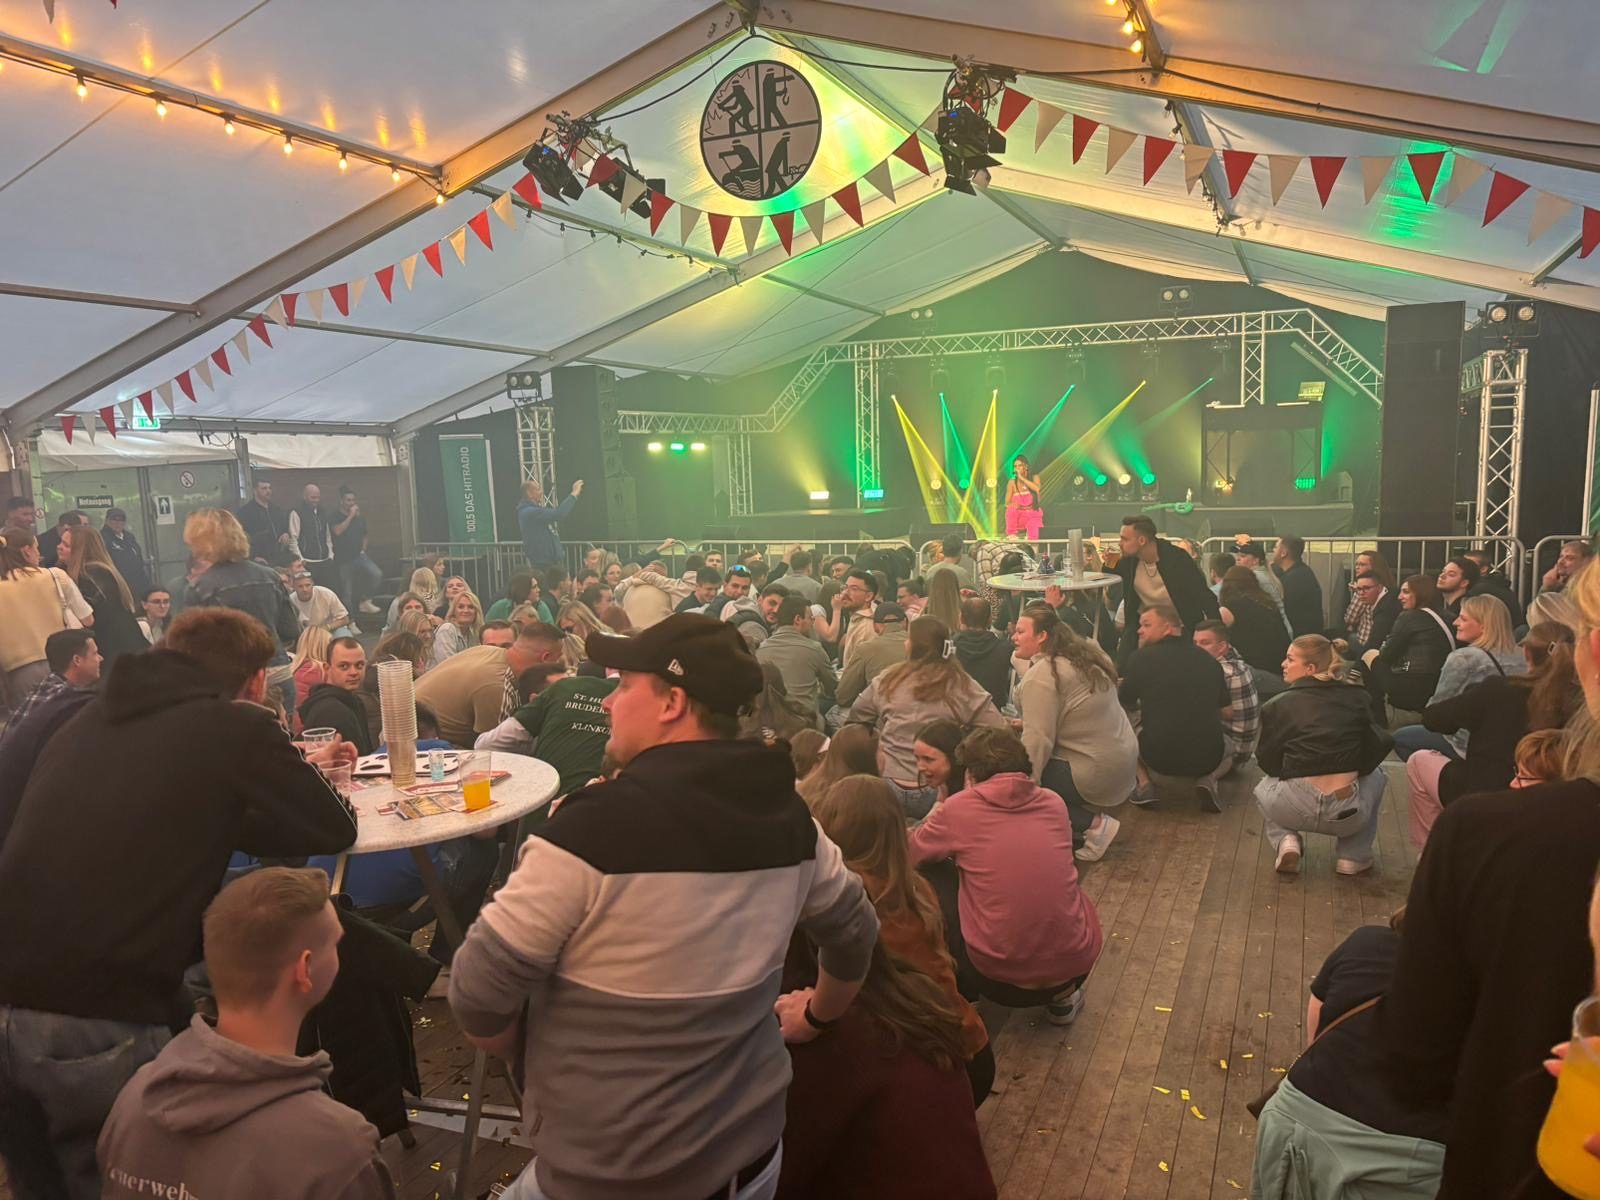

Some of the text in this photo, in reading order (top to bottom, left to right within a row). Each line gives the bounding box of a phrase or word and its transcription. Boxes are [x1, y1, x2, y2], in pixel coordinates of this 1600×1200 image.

[460, 446, 473, 491] HITRADIO
[465, 493, 475, 512] DAS
[565, 701, 608, 714] BRUDER
